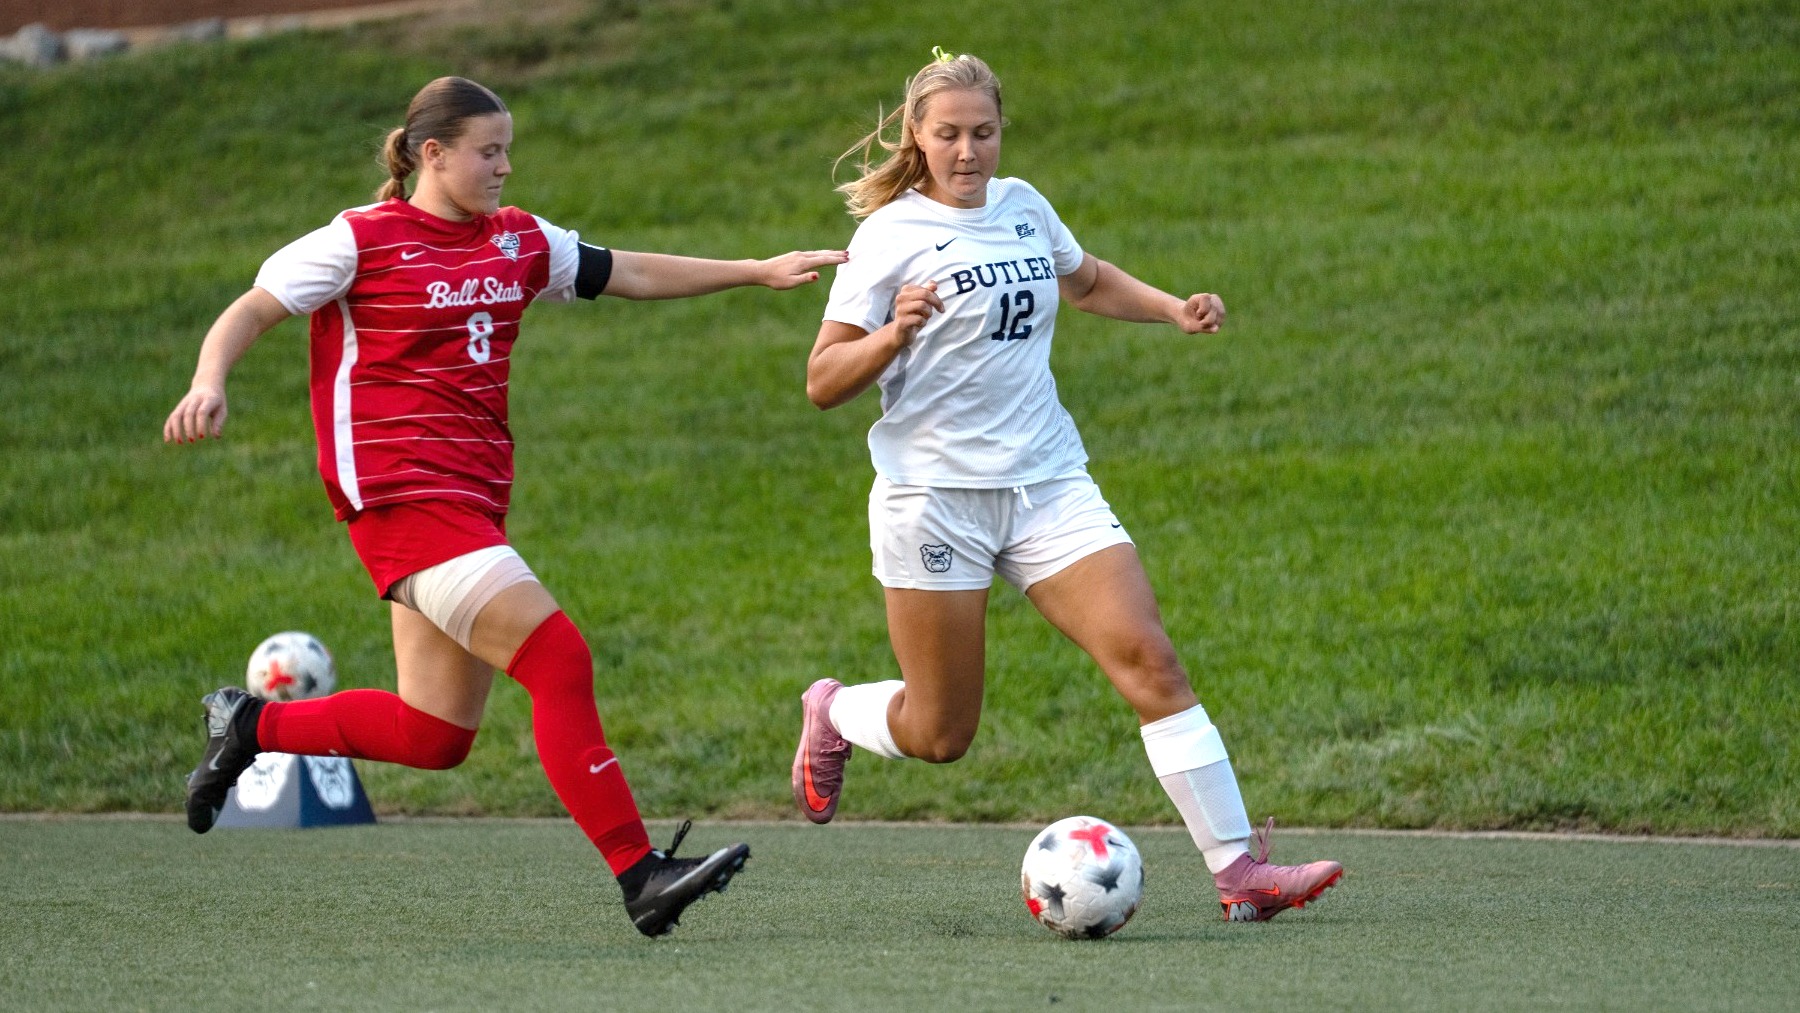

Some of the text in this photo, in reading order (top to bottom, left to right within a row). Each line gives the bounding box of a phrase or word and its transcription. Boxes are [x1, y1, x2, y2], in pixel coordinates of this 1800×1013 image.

[424, 278, 479, 309] Ball
[951, 257, 1056, 295] BUTLER
[466, 311, 494, 364] 8
[991, 290, 1035, 341] 12
